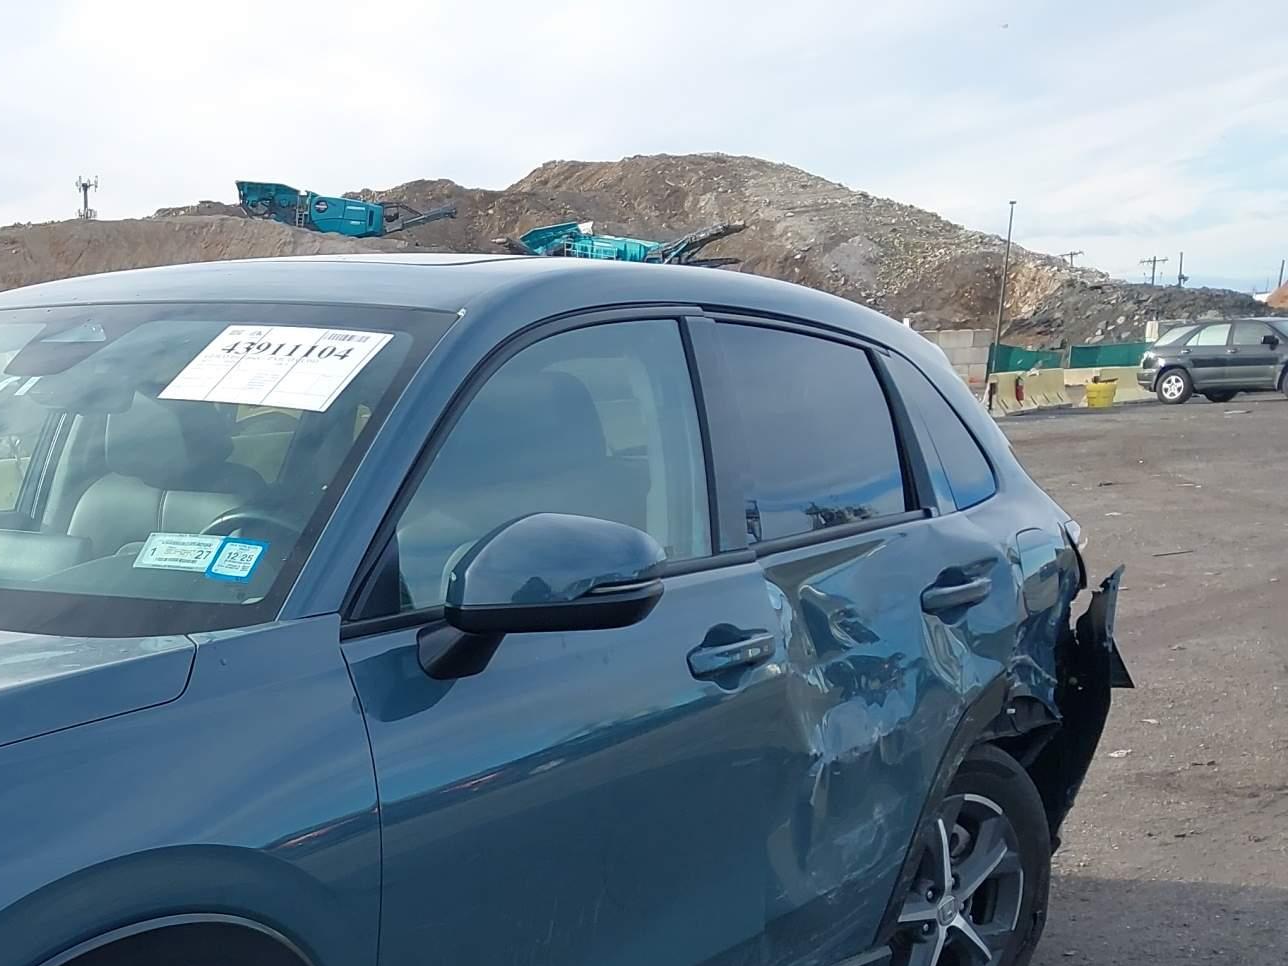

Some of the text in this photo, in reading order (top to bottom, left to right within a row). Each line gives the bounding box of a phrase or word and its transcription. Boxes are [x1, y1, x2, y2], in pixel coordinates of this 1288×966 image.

[221, 340, 354, 361] 43911104
[150, 547, 158, 557] 1
[194, 550, 212, 560] 27
[226, 551, 255, 563] 12 25
